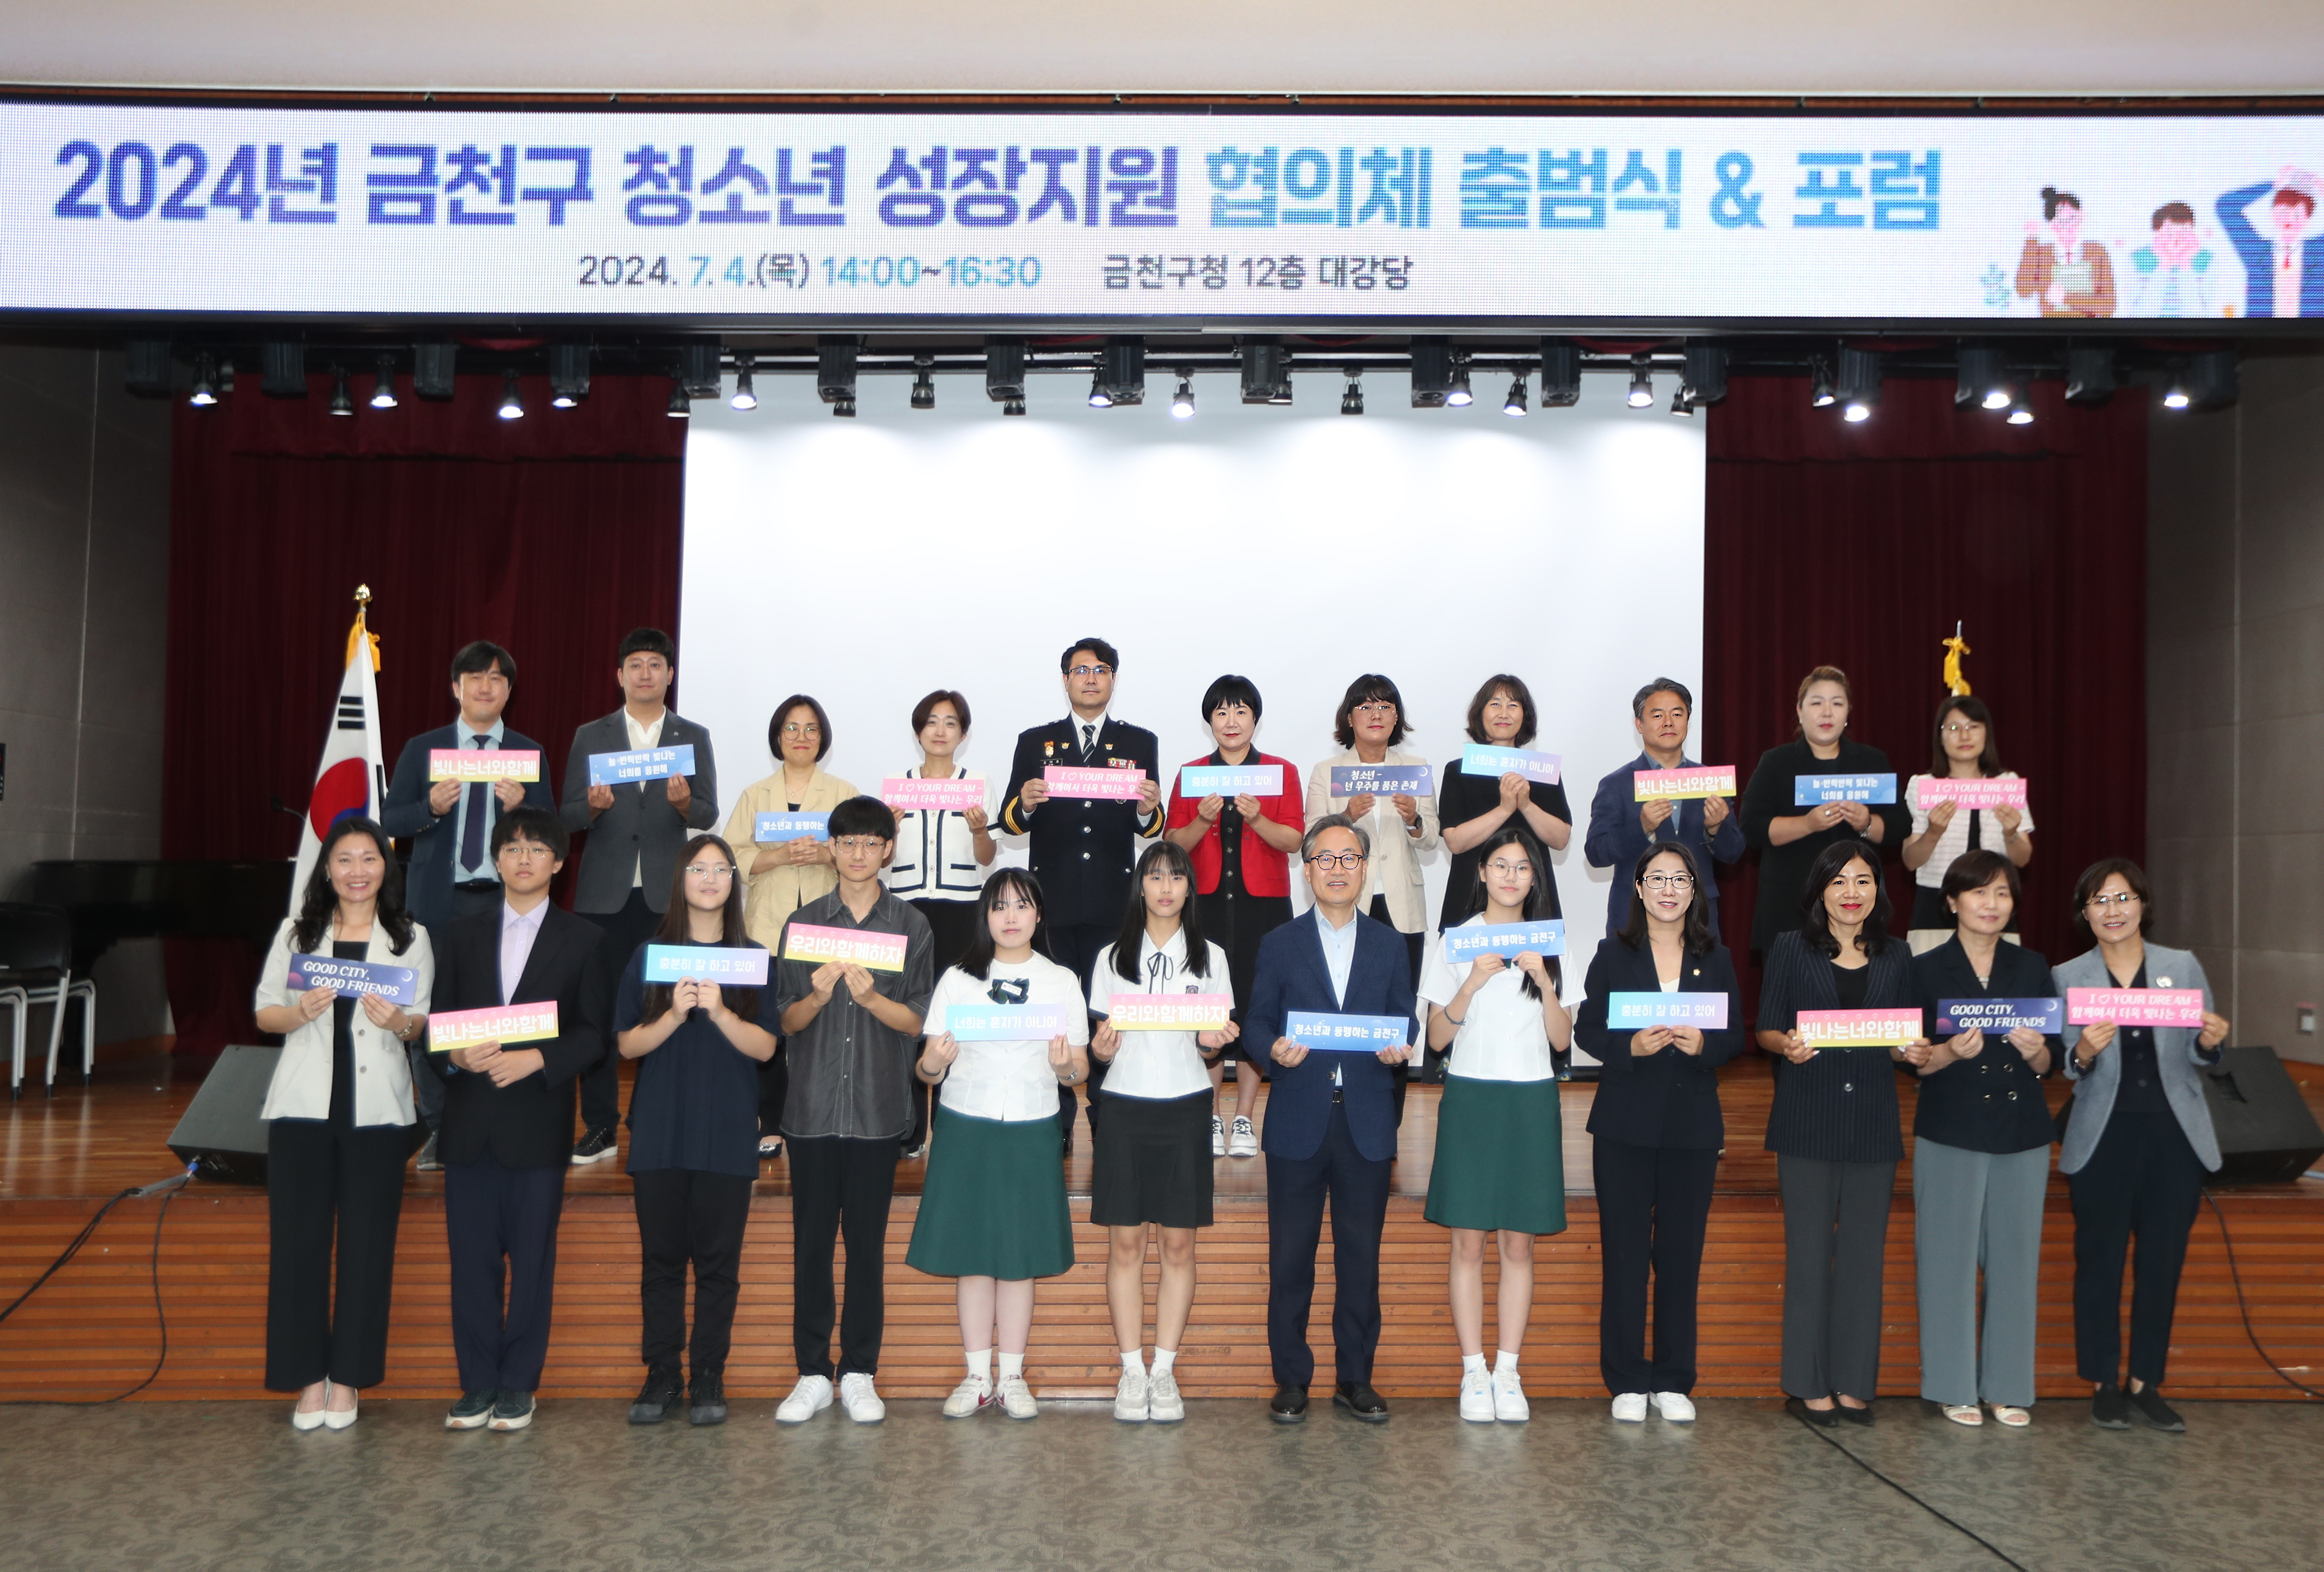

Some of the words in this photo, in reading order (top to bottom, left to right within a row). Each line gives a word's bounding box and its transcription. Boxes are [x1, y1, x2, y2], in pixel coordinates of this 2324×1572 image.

[54, 139, 337, 226] 2024년
[366, 142, 594, 228] 금천구
[622, 143, 846, 228] 청소년
[876, 145, 1179, 228] 성장지원
[1205, 147, 1432, 229] 협의체
[1460, 147, 1682, 229] 출범식
[1709, 151, 1765, 229] &
[1792, 149, 1942, 231] 포럼
[579, 255, 677, 286] 2024.
[689, 255, 713, 286] 7.
[821, 255, 1042, 288] 14:00~16:30
[1101, 254, 1228, 289] 금천구청
[1240, 254, 1305, 289] 12층
[1319, 254, 1414, 290] 대강당
[608, 757, 616, 766] 늘
[619, 753, 650, 766] 반짝반짝
[653, 750, 675, 762] 빛나는
[1470, 754, 1497, 766] 너희는
[1500, 757, 1526, 770] 혼자가
[1529, 762, 1554, 774] 아니야
[434, 759, 537, 776] 빛나는너와함께
[619, 767, 641, 778] 너희를
[645, 764, 668, 775] 응원해
[1080, 773, 1103, 781] YOUR
[1106, 773, 1138, 782] DREAM
[1192, 776, 1218, 787] 충분히
[1222, 776, 1230, 786] 잘
[1234, 776, 1250, 786] 하고
[1254, 775, 1271, 786] 있어
[1351, 770, 1375, 780] 청소년
[899, 784, 904, 792] I
[917, 784, 942, 792] YOUR
[1083, 783, 1098, 793] 더욱
[1101, 784, 1125, 794] 빛나는
[1128, 785, 1138, 794] 우
[1345, 782, 1353, 792] 넌
[1356, 781, 1379, 791] 우주를
[1382, 781, 1399, 791] 품은
[1401, 780, 1418, 790] 존재
[1638, 775, 1733, 796] 빛나는너와함께
[1954, 784, 1982, 793] YOUR
[1982, 784, 2018, 793] DREAM
[885, 794, 918, 804] 함께여서
[920, 794, 936, 804] 더욱
[939, 795, 963, 805] 빛나는
[966, 795, 982, 805] 우리
[763, 821, 793, 830] 청소년과
[795, 821, 824, 830] 동행하는
[1454, 937, 1488, 949] 청소년과
[1492, 934, 1526, 947] 동행하는
[1531, 931, 1556, 944] 금천구
[789, 934, 902, 964] 우리와함께하자
[304, 961, 338, 975] GOOD
[340, 965, 370, 980] CITY,
[660, 957, 691, 971] 충분히
[695, 959, 706, 971] 잘
[709, 959, 730, 972] 하고
[735, 960, 755, 972] 있어
[311, 976, 345, 989] GOOD
[348, 980, 400, 996] FRIENDS
[2089, 994, 2096, 1004] I
[2113, 994, 2146, 1005] YOUR
[2149, 995, 2192, 1005] DREAM
[1112, 1004, 1227, 1023] 우리와함께하자
[1621, 1004, 1652, 1016] 충분히
[1656, 1004, 1666, 1016] 잘
[1670, 1004, 1690, 1016] 하고
[1694, 1004, 1715, 1017] 있어
[1950, 1004, 1984, 1015] GOOD
[1985, 1004, 2016, 1015] CITY,
[434, 1013, 554, 1044] 빛나는너와함께
[955, 1016, 986, 1029] 너희는
[990, 1016, 1022, 1028] 혼자가
[1026, 1015, 1057, 1028] 아니야
[1959, 1017, 1993, 1027] GOOD
[1994, 1016, 2046, 1027] FRIENDS
[1295, 1024, 1331, 1036] 청소년과
[1335, 1026, 1369, 1038] 동행하는
[1373, 1028, 1399, 1039] 금천구
[1800, 1019, 1919, 1040] 빛나는너와함께
